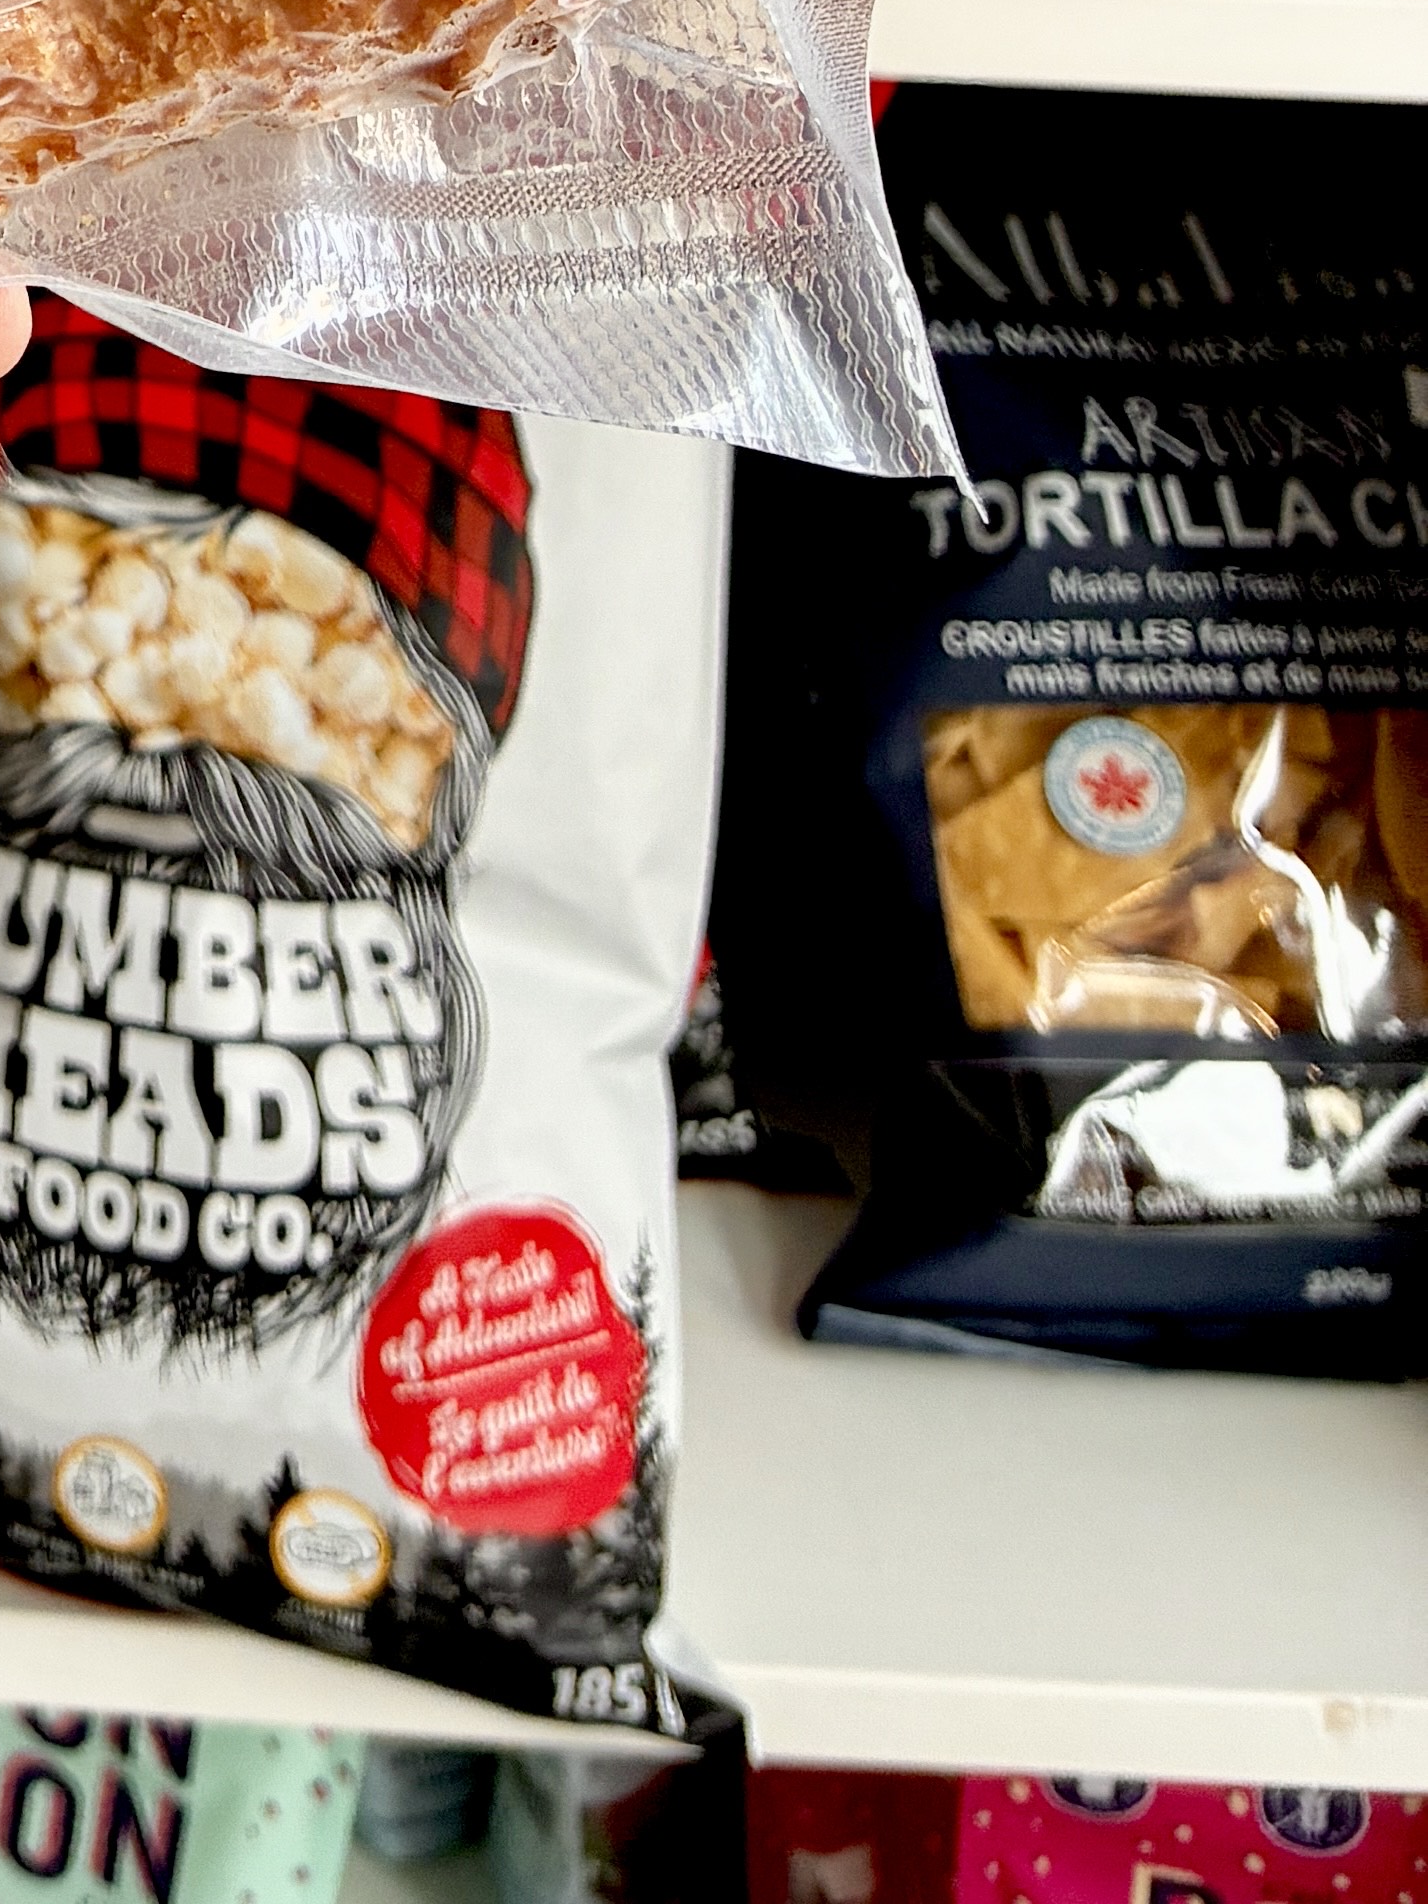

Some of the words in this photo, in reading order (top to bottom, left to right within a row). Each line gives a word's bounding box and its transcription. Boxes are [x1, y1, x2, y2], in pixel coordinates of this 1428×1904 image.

[909, 470, 1339, 559] TORTILLA
[941, 618, 1196, 659] CROUSTILLES
[197, 1191, 335, 1275] CO.
[552, 1665, 649, 1723] 185
